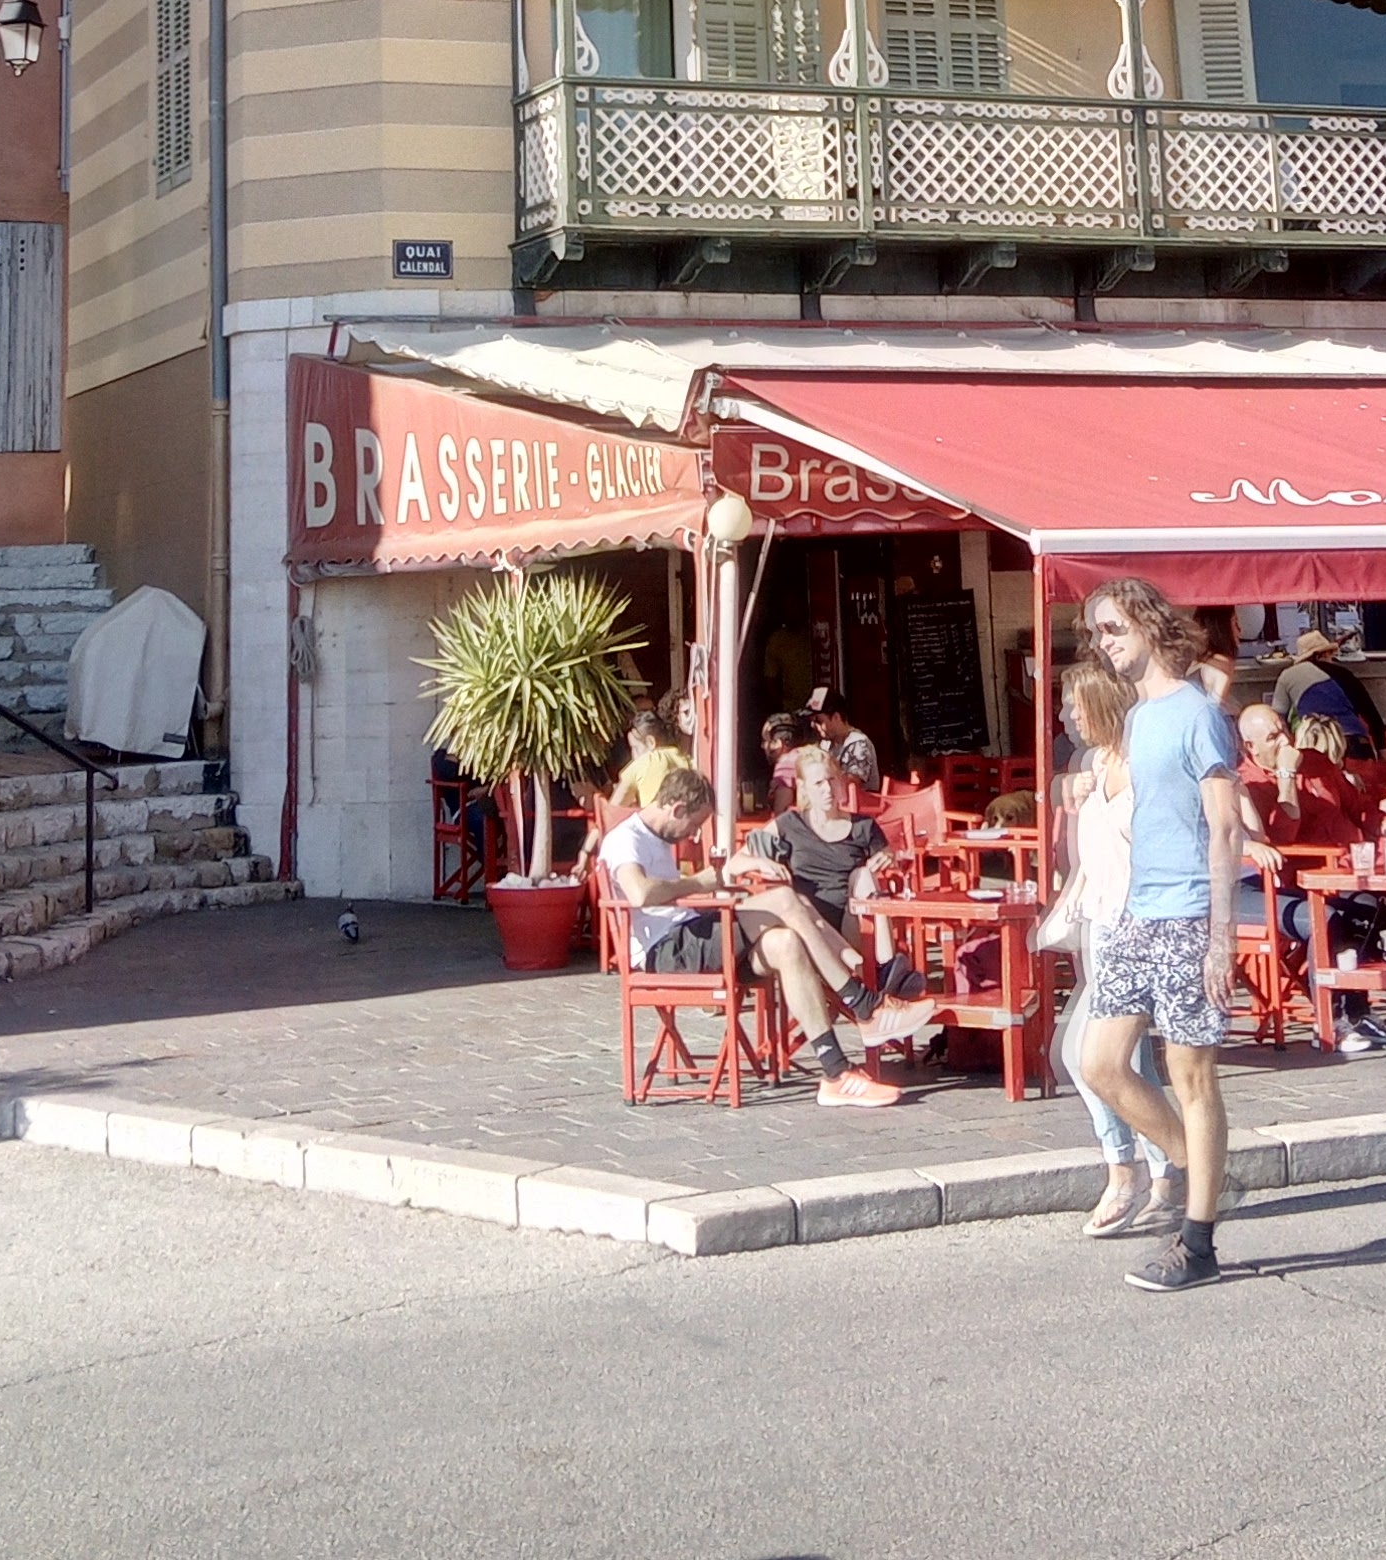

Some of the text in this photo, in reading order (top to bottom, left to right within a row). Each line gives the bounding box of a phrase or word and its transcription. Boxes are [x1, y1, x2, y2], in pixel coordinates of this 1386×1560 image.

[405, 245, 442, 259] QUAI
[399, 260, 447, 274] CALENDAL
[304, 421, 562, 529] BRASSERIE
[585, 441, 667, 503] GLACIER
